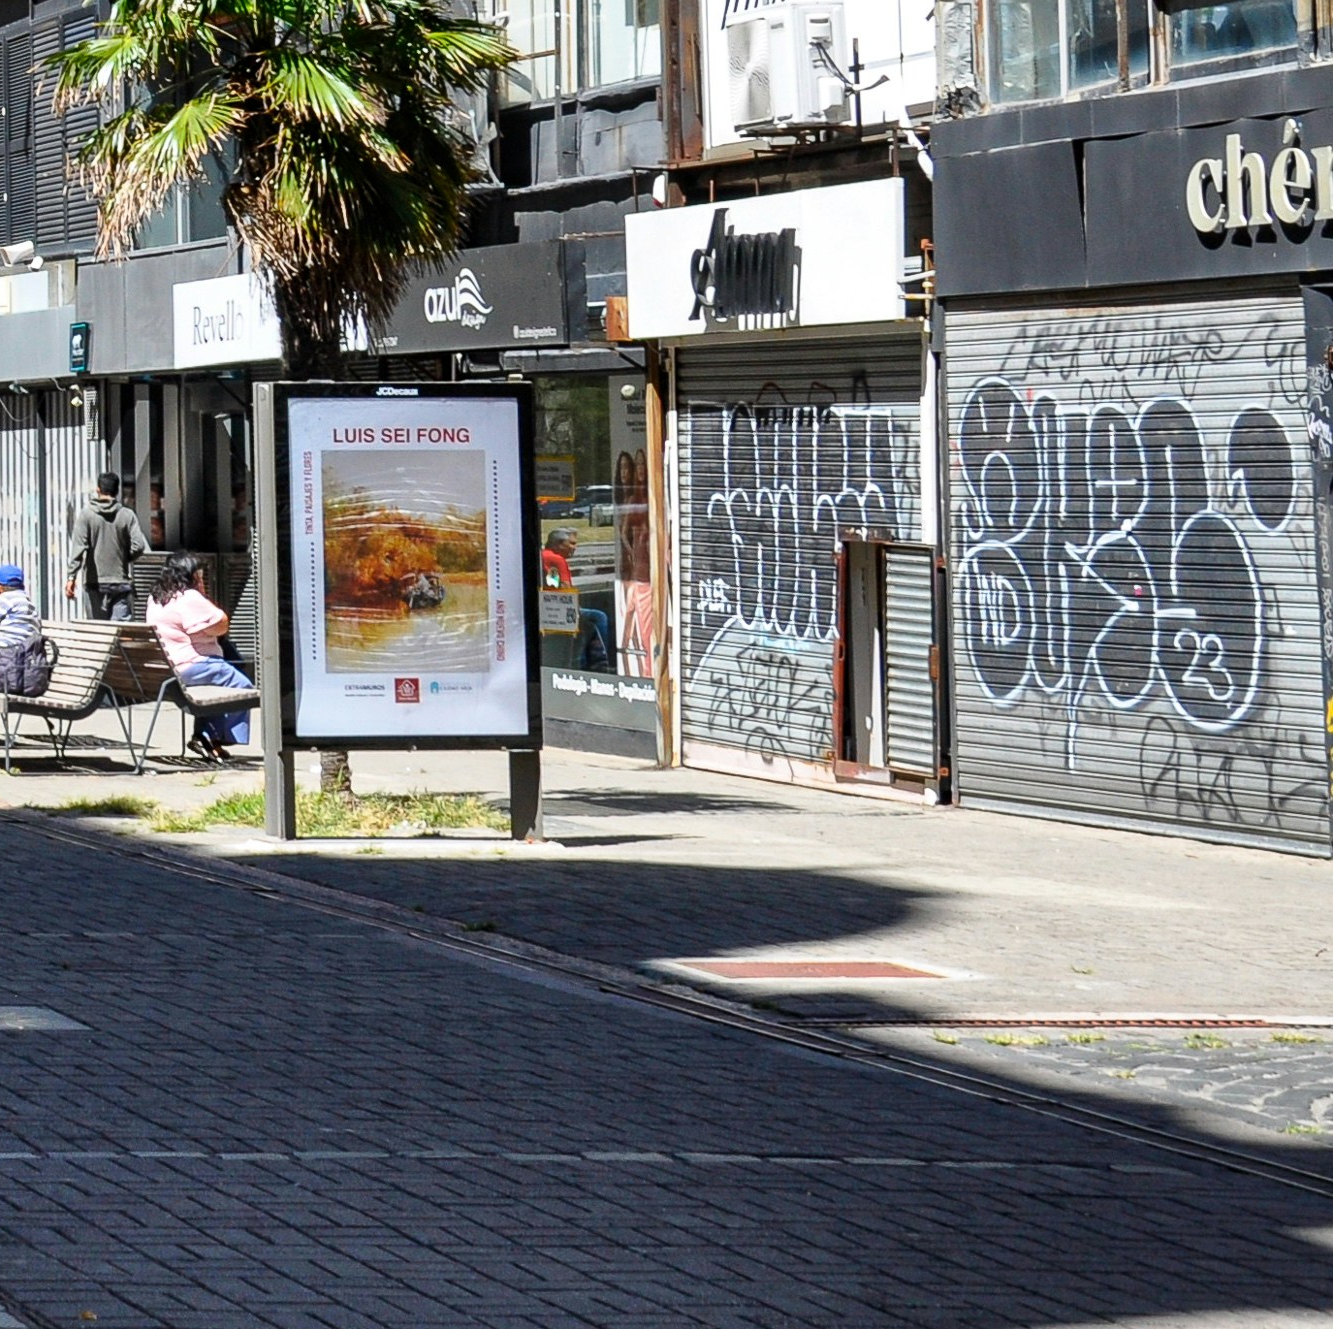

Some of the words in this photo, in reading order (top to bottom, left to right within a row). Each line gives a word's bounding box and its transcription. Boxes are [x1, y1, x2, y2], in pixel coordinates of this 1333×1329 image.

[425, 275, 462, 323] azul
[376, 386, 419, 397] JCDecaux
[332, 427, 375, 444] LUIS
[381, 427, 411, 444] SEI
[417, 427, 471, 444] FONG
[303, 451, 312, 475] FLORES
[304, 483, 313, 514] PAISAJES
[1174, 630, 1235, 702] 23
